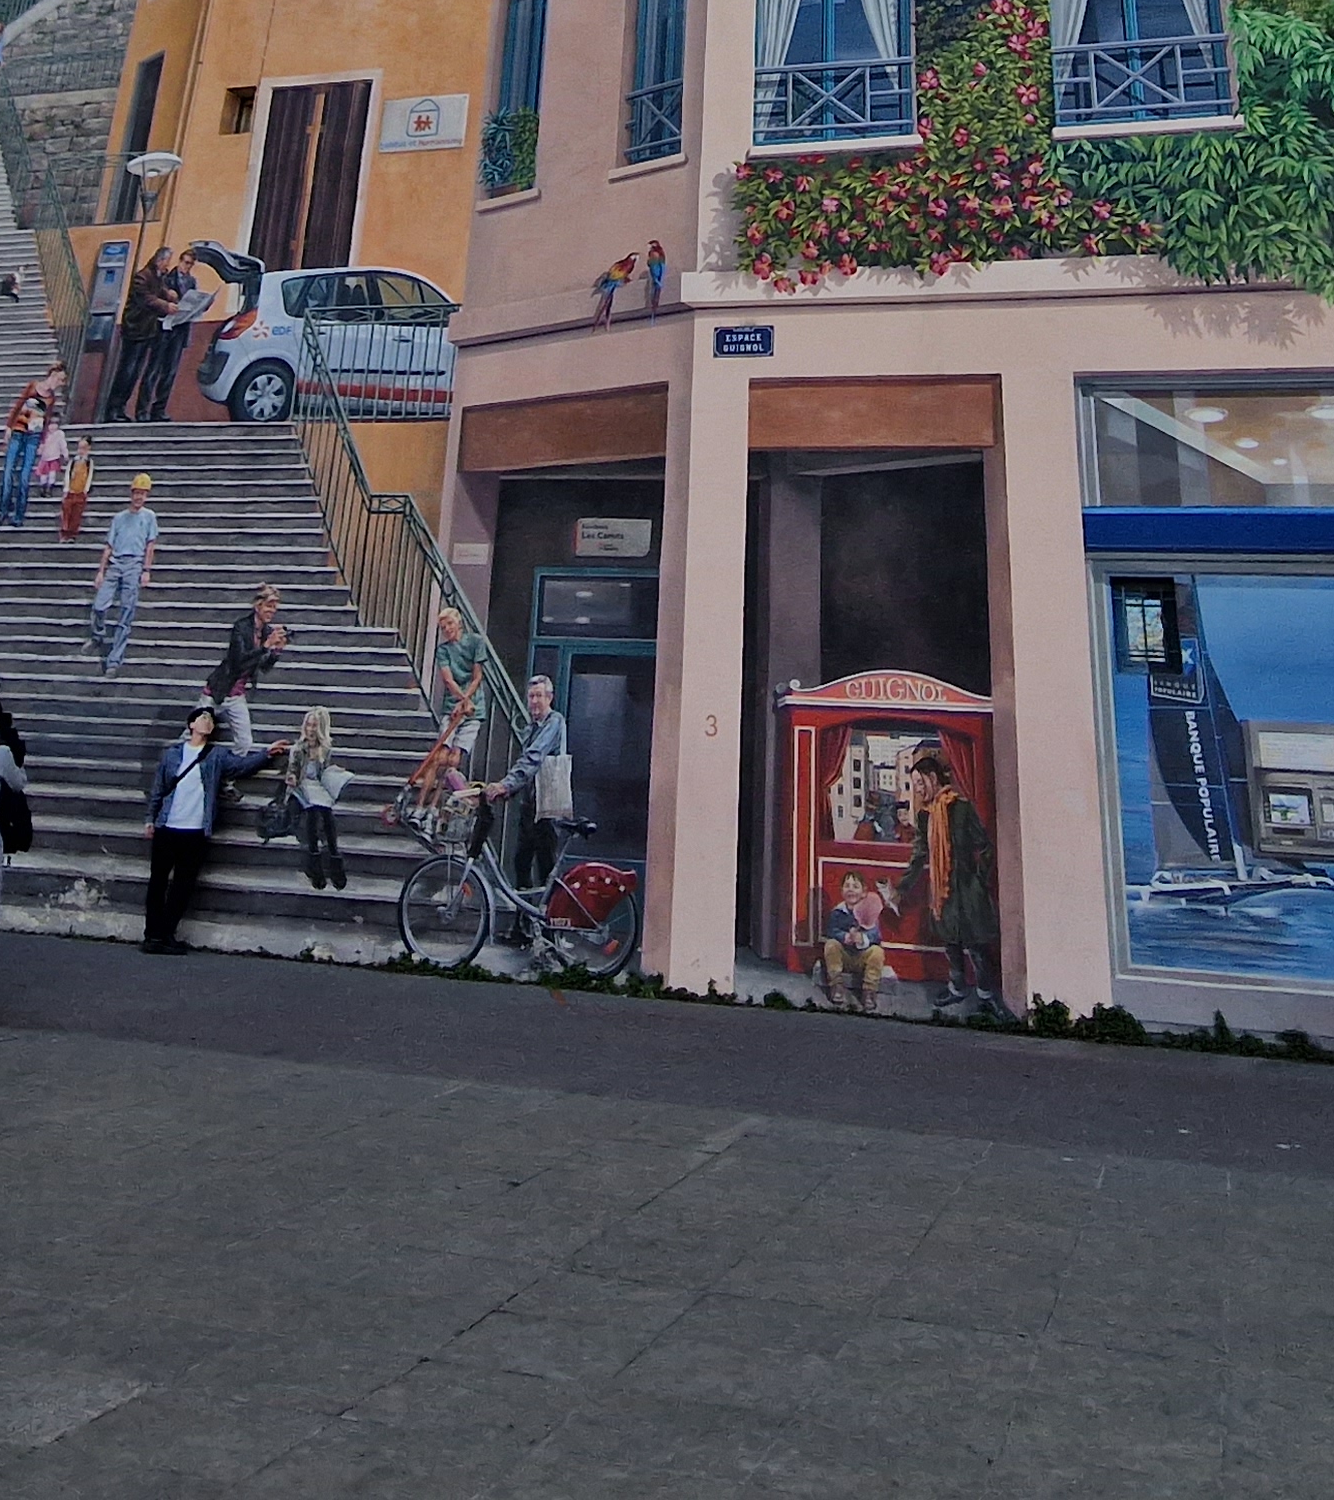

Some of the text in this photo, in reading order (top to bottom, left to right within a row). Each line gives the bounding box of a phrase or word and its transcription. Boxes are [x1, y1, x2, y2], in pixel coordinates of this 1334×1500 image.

[722, 343, 765, 353] GUIGNOL
[725, 333, 762, 342] ESPACE
[846, 677, 947, 701] GUIGNOL
[704, 714, 718, 738] 3
[1184, 710, 1221, 862] BANQUE POPULAIRE
